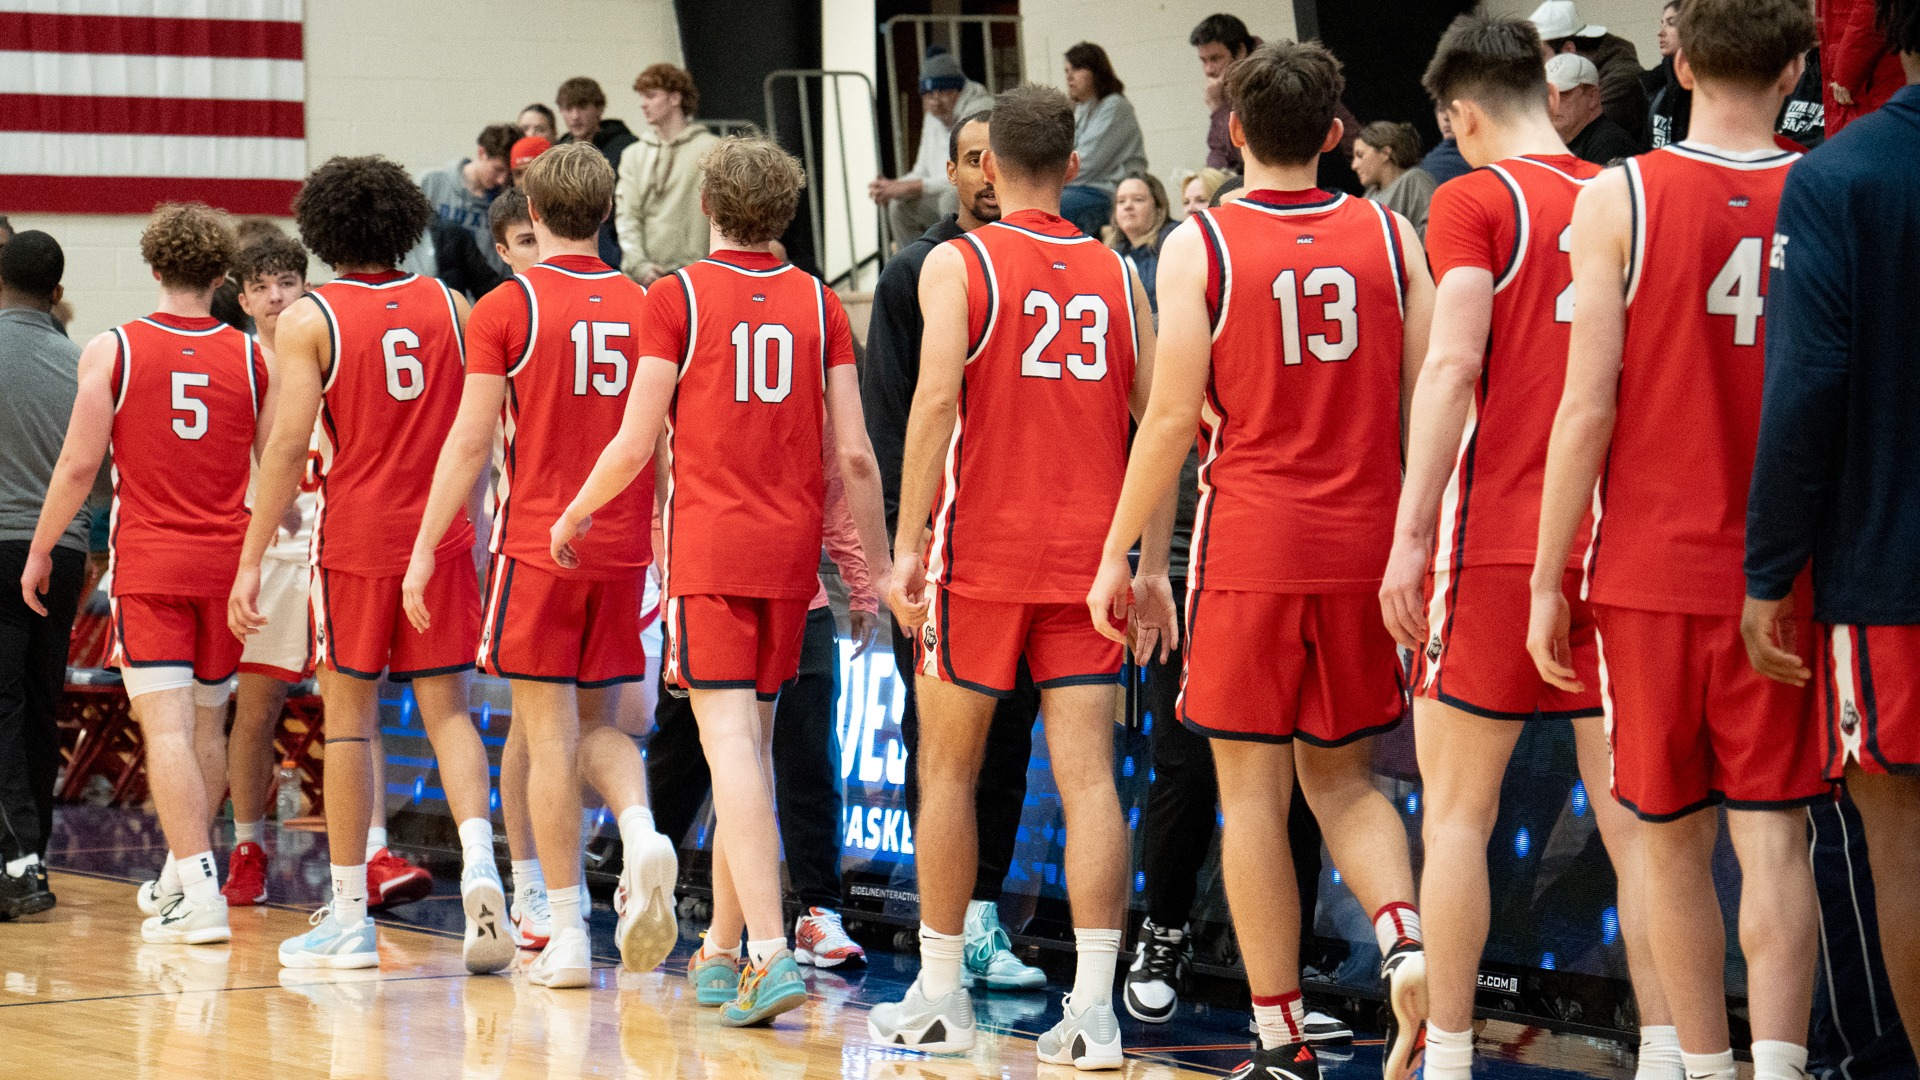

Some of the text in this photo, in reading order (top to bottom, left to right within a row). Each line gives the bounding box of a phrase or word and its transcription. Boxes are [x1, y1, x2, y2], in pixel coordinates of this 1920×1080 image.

[1296, 236, 1314, 244] MAC
[1728, 198, 1750, 208] MAC
[1271, 266, 1358, 366] 13
[1707, 237, 1764, 345] 4
[381, 327, 426, 402] 6
[570, 320, 630, 397] 15
[731, 321, 794, 404] 10
[1021, 289, 1110, 381] 23
[170, 371, 209, 440] 5
[842, 805, 914, 855] ASKE
